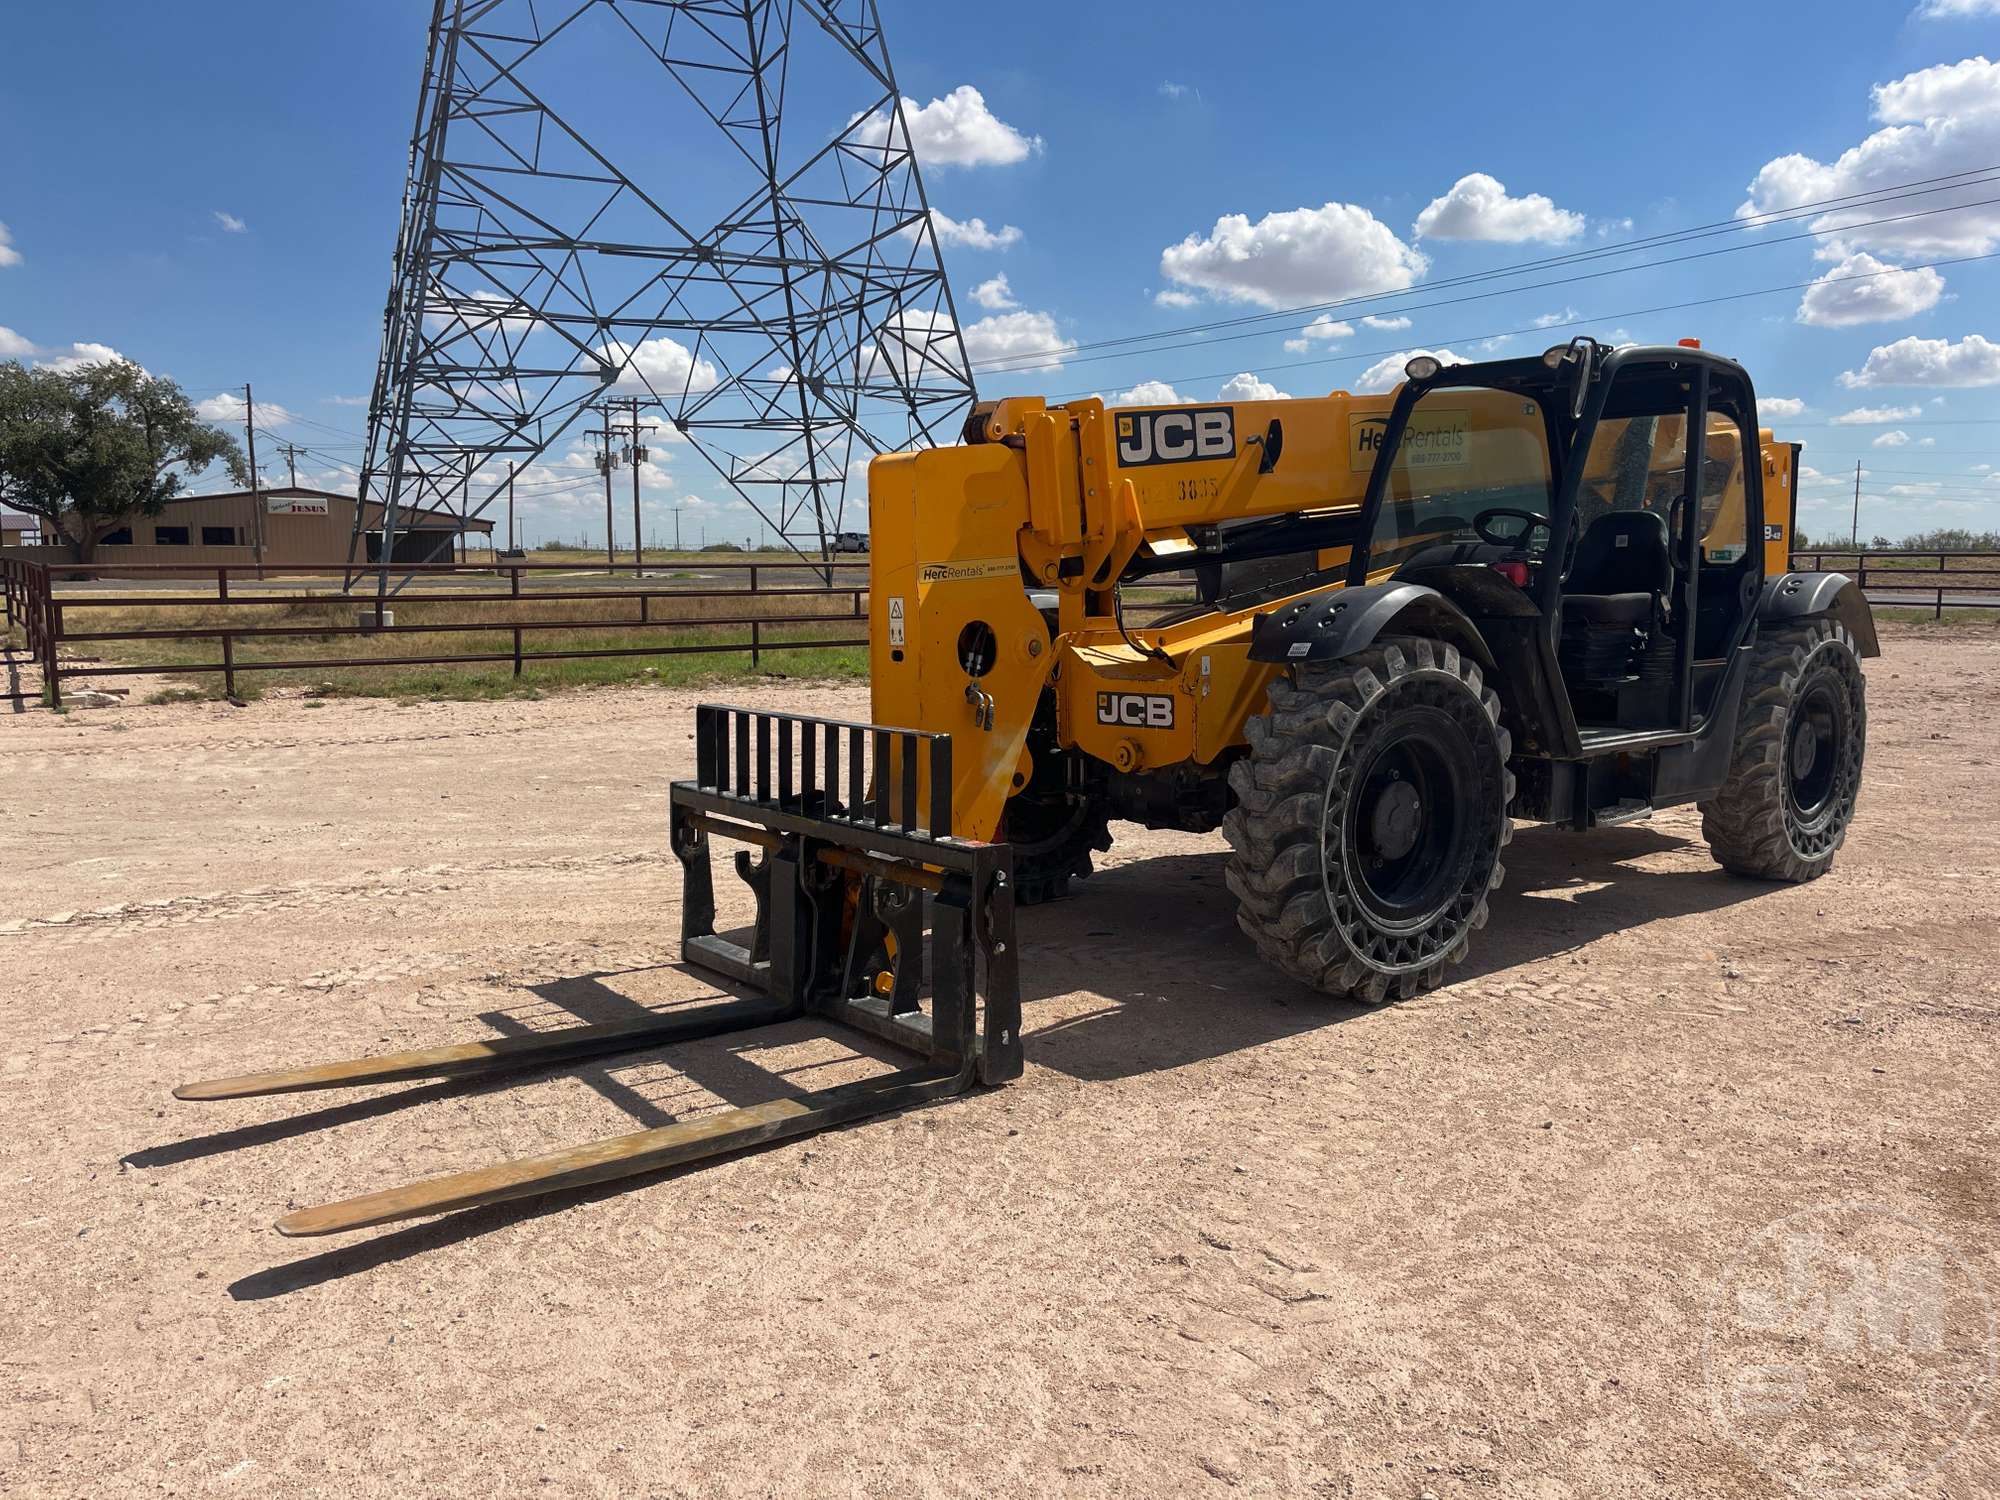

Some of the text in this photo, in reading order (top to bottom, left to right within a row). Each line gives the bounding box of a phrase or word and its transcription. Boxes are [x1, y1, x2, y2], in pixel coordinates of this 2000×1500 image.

[1120, 411, 1233, 462] JCB
[1358, 424, 1463, 450] HeRentals
[924, 565, 983, 580] HercRentals
[1099, 695, 1173, 726] JCB
